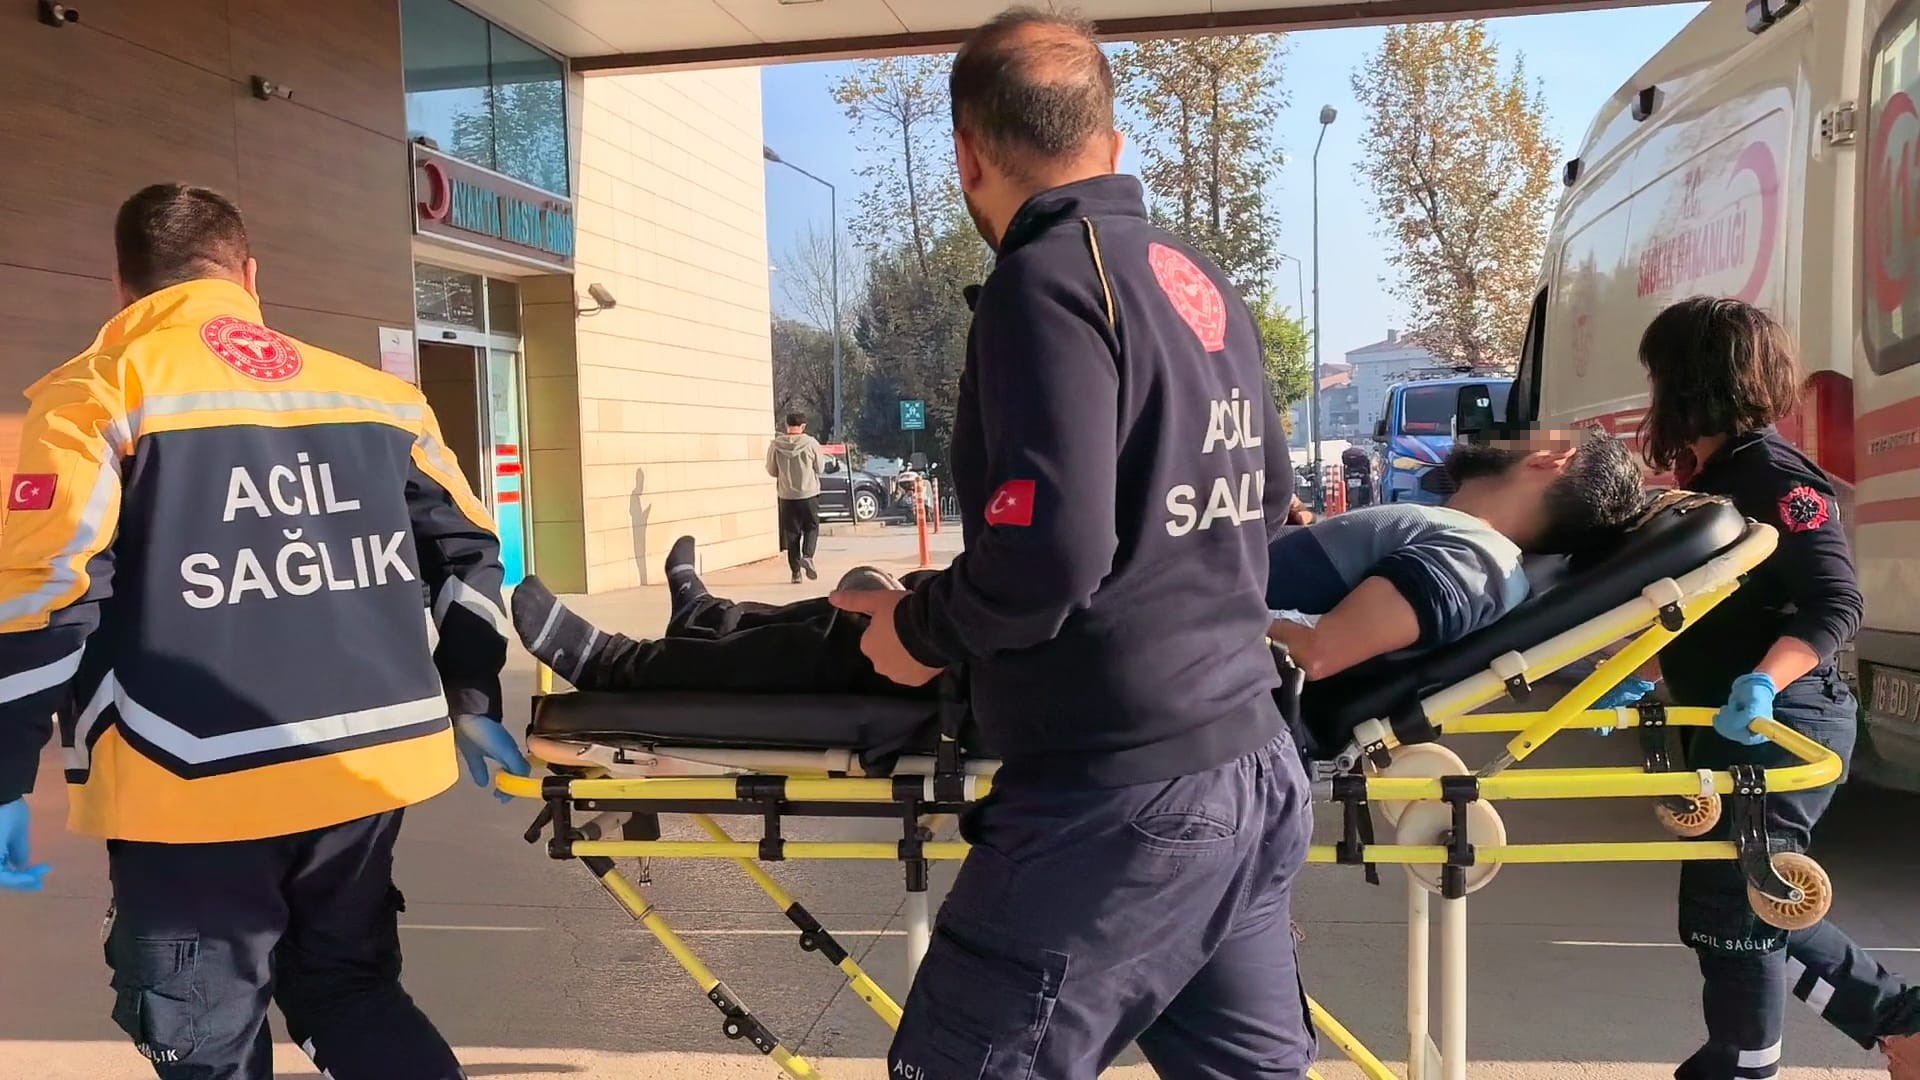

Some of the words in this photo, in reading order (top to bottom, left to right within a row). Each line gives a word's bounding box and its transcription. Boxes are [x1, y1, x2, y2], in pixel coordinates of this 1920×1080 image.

[452, 179, 501, 237] AYAKTA
[506, 194, 542, 249] HASTA
[1202, 388, 1261, 454] ACİL
[223, 452, 360, 522] ACİL
[180, 527, 416, 609] SAĞLIK
[1725, 937, 1775, 951] SAĞLIK
